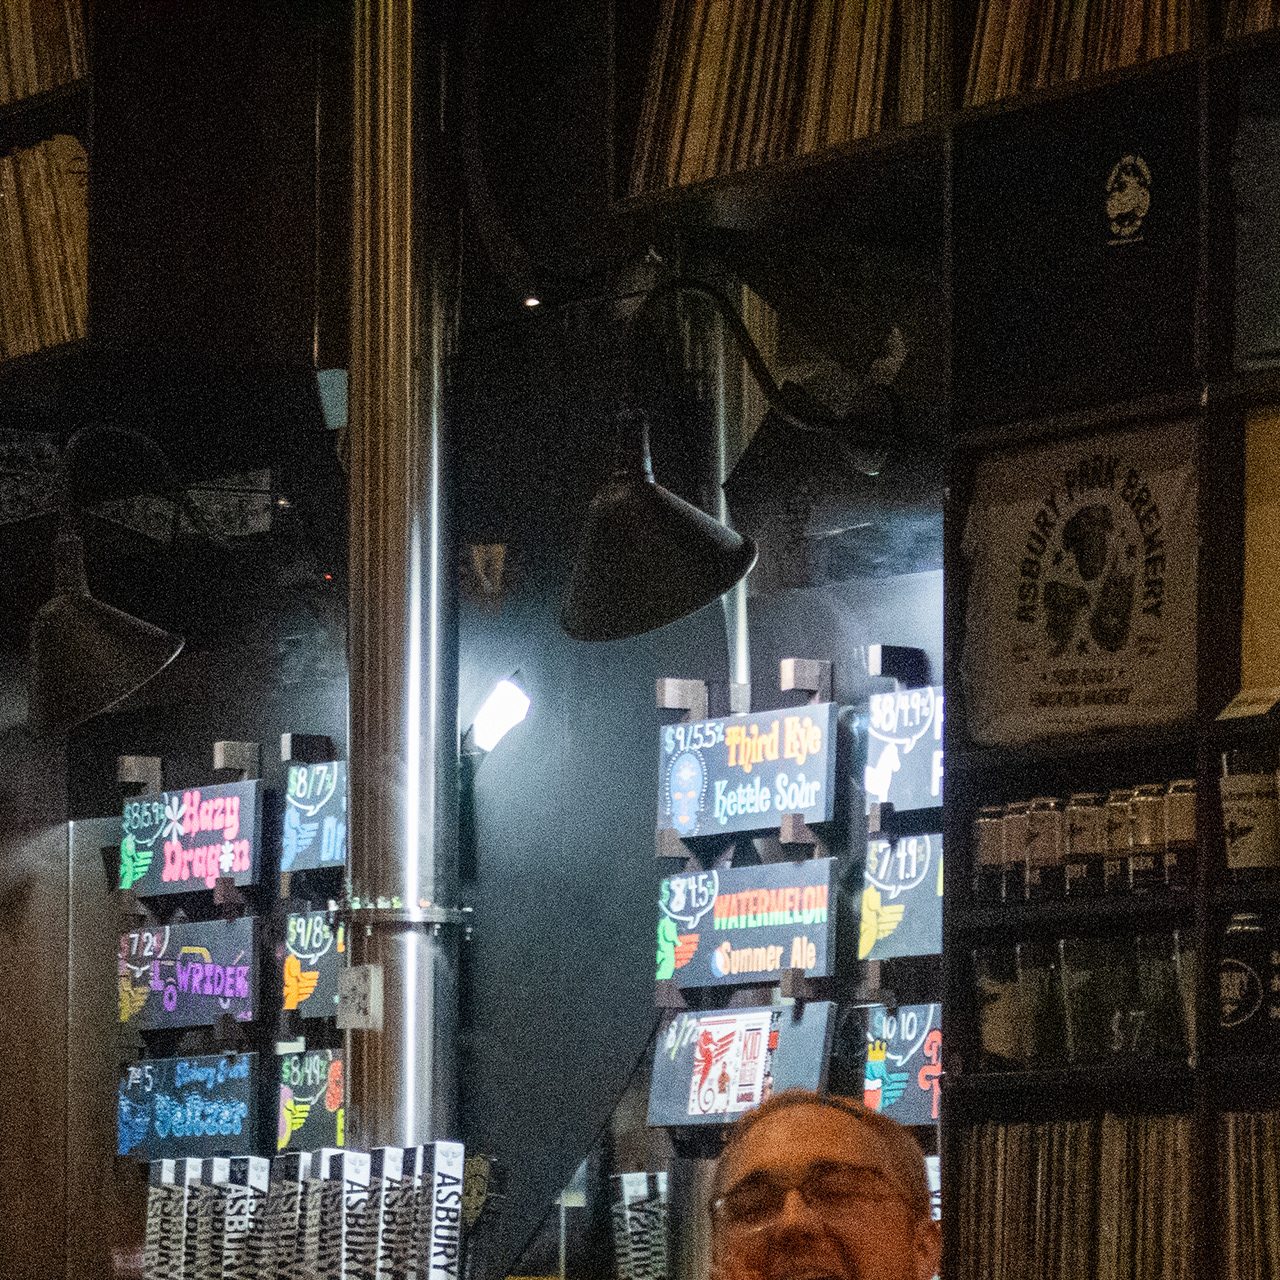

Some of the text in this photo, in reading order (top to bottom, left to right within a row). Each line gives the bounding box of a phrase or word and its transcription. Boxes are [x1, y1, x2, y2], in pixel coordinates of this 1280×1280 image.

[725, 723, 780, 774] Third
[182, 789, 240, 841] Hazy
[714, 776, 770, 825] Kettle
[714, 884, 828, 931] WATERMELON
[719, 935, 817, 976] Summer Ale
[343, 1179, 371, 1279] ASBURY
[431, 1171, 463, 1278] ASBURY
